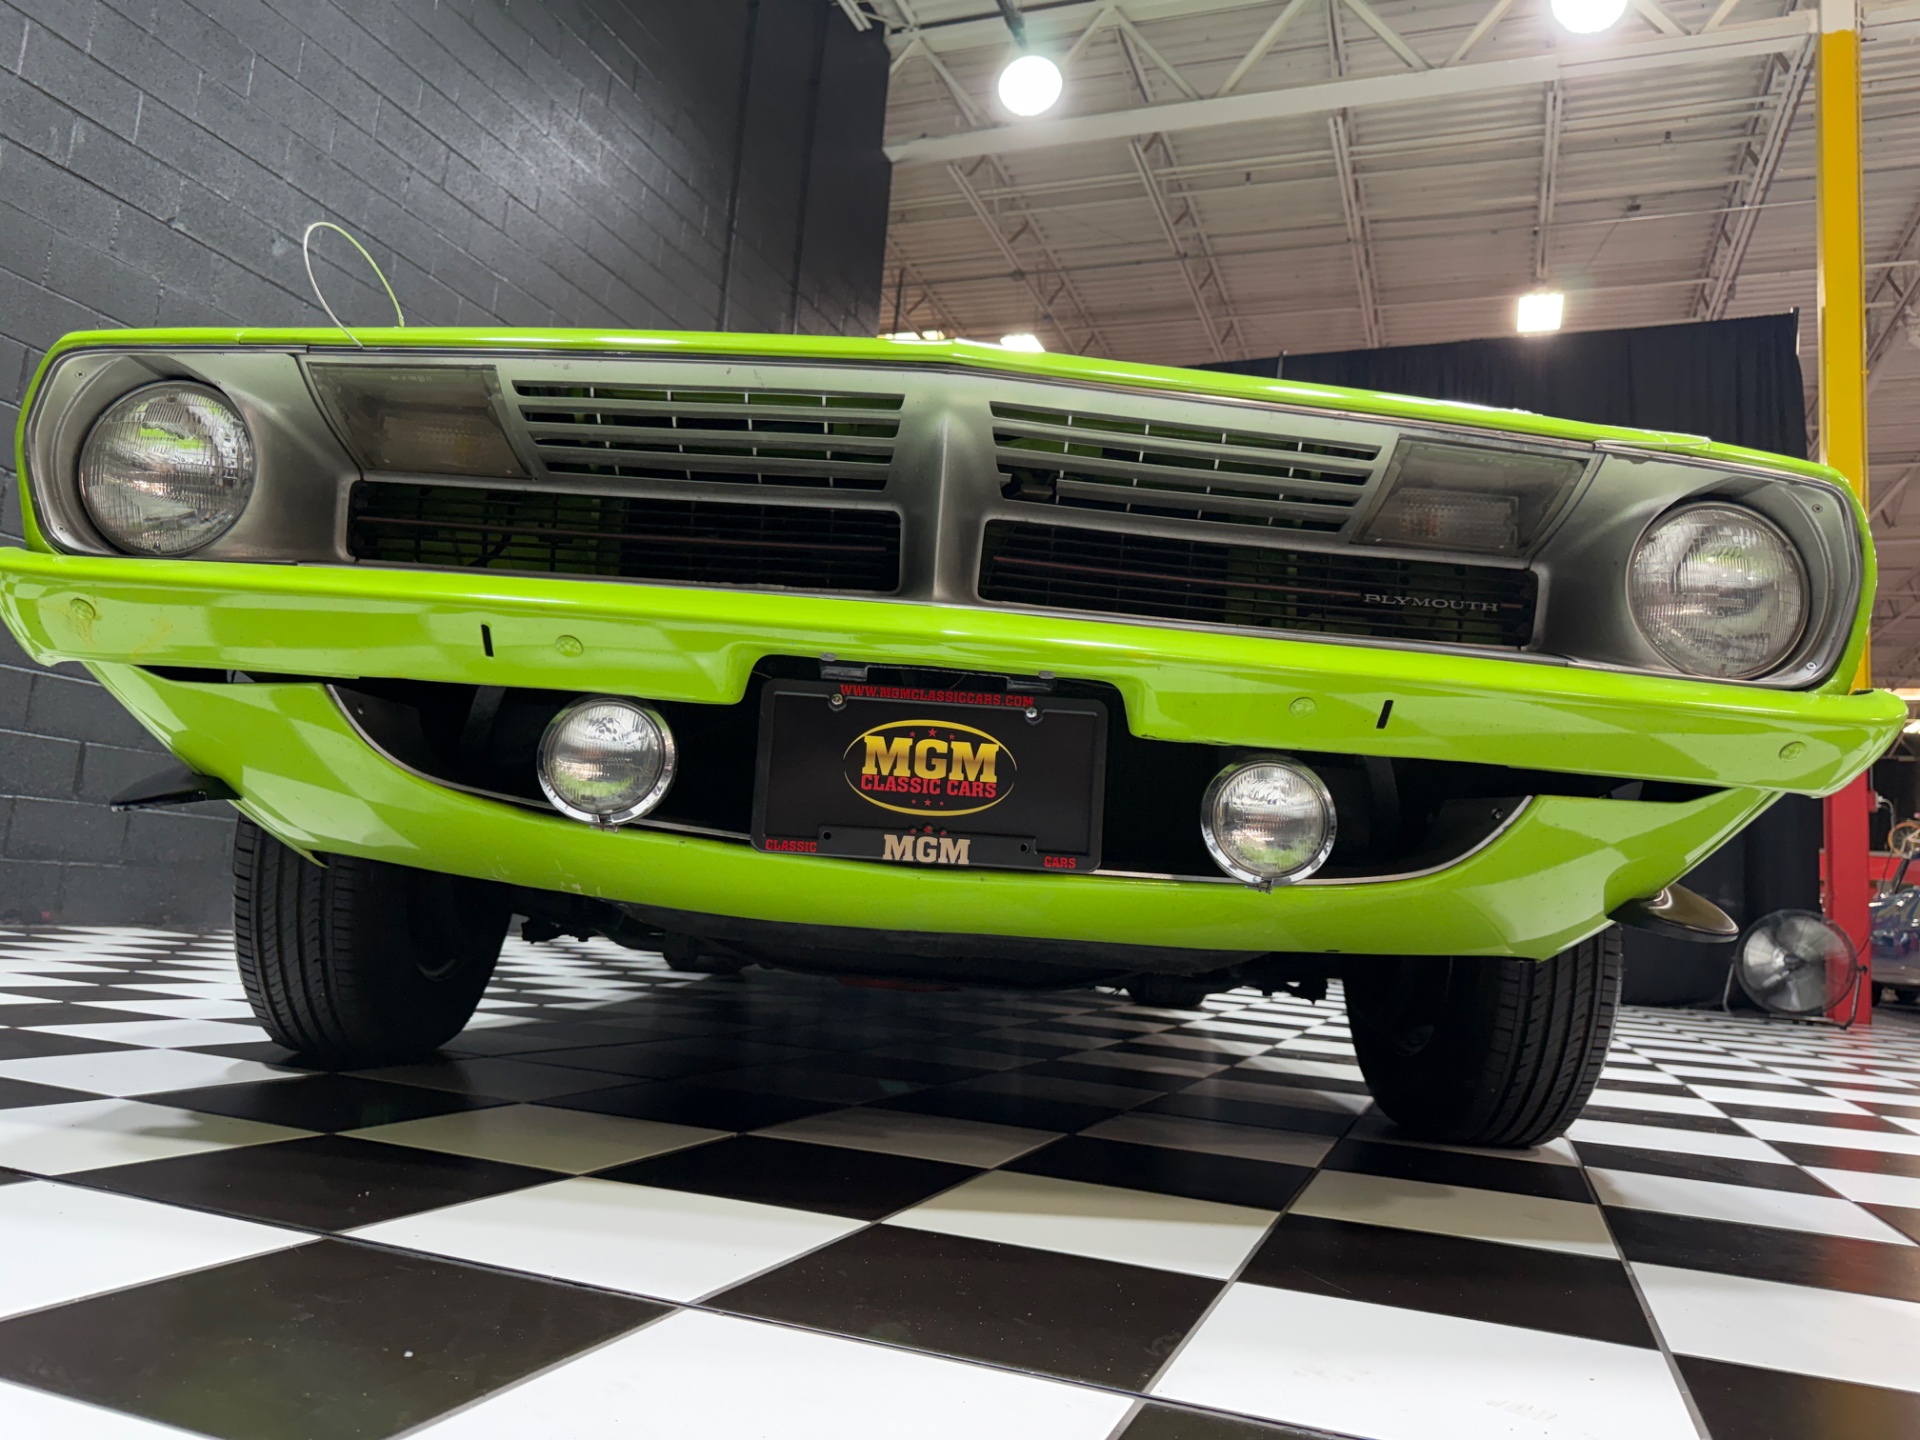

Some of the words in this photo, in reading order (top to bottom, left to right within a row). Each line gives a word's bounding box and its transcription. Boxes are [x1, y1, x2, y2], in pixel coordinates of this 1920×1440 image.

[1364, 593, 1498, 612] PLYMOUTH
[840, 685, 1034, 706] WWW.MGMCLASSICCARS.COM
[862, 735, 999, 783] MGM
[861, 774, 941, 795] CLASSIC
[946, 780, 997, 798] CARS
[765, 839, 817, 853] CLASSIC
[883, 834, 971, 865] MGM
[1043, 856, 1076, 869] CARS
